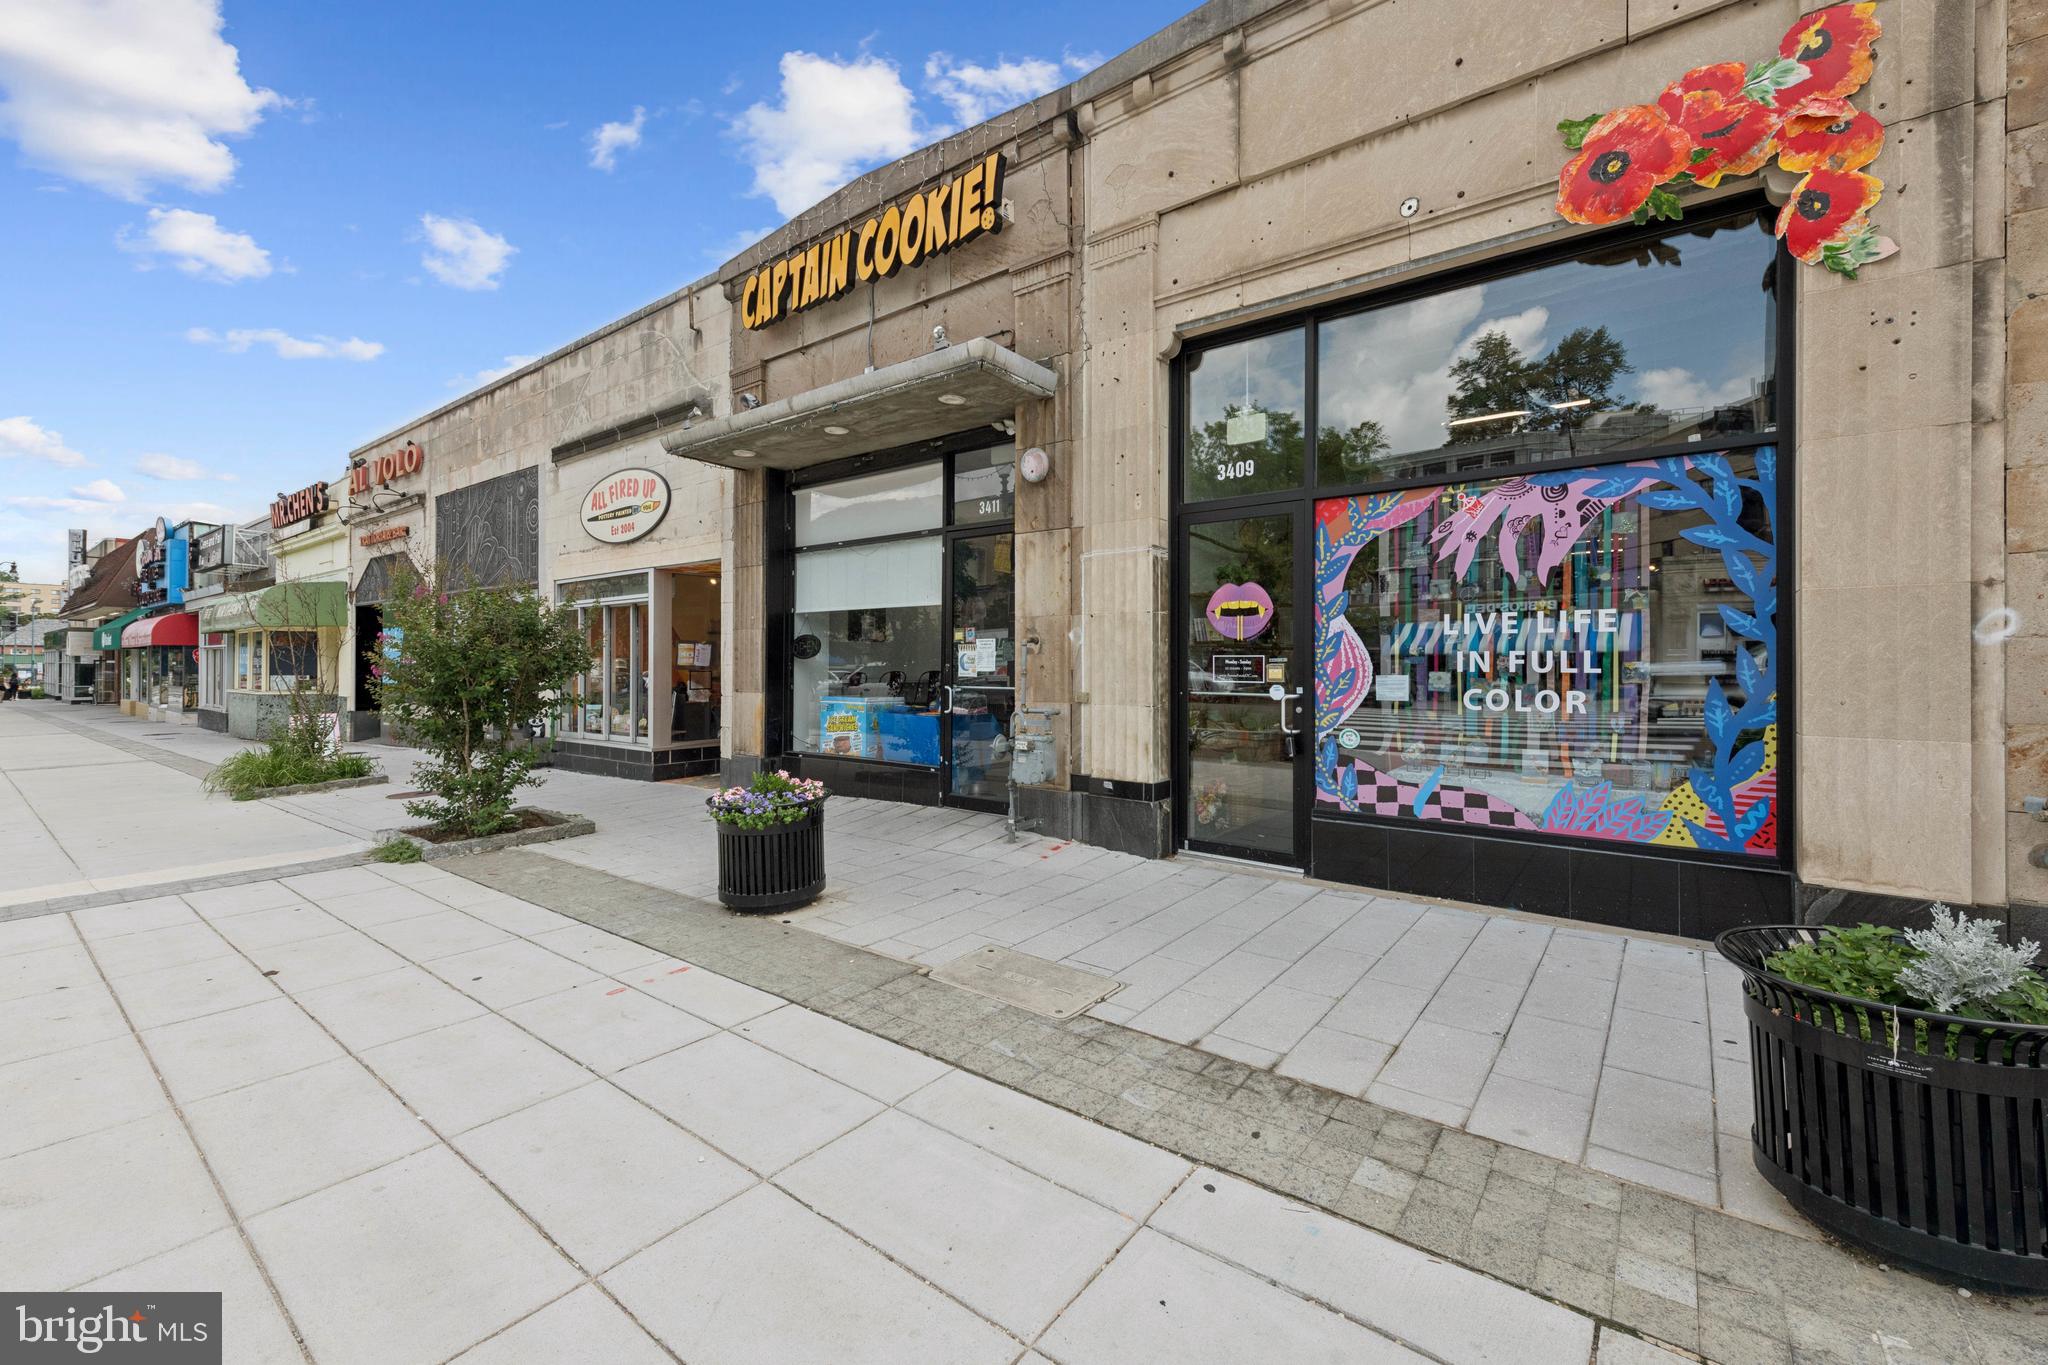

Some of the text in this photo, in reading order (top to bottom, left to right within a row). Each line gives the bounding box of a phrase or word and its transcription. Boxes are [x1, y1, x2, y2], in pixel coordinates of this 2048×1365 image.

[741, 151, 1005, 330] CAPTAIN COOKIE!
[348, 445, 423, 496] AL VOLO
[1217, 459, 1254, 481] 3409
[591, 478, 656, 511] ALL FIRED UP
[979, 499, 1000, 514] 3411
[598, 512, 614, 520] POTTERY
[615, 508, 632, 517] PAINTED
[611, 522, 635, 536] Est 2004
[1443, 608, 1617, 635] LIVE LIFE
[1457, 650, 1602, 674] IN FULL
[1463, 688, 1587, 714] COLOR
